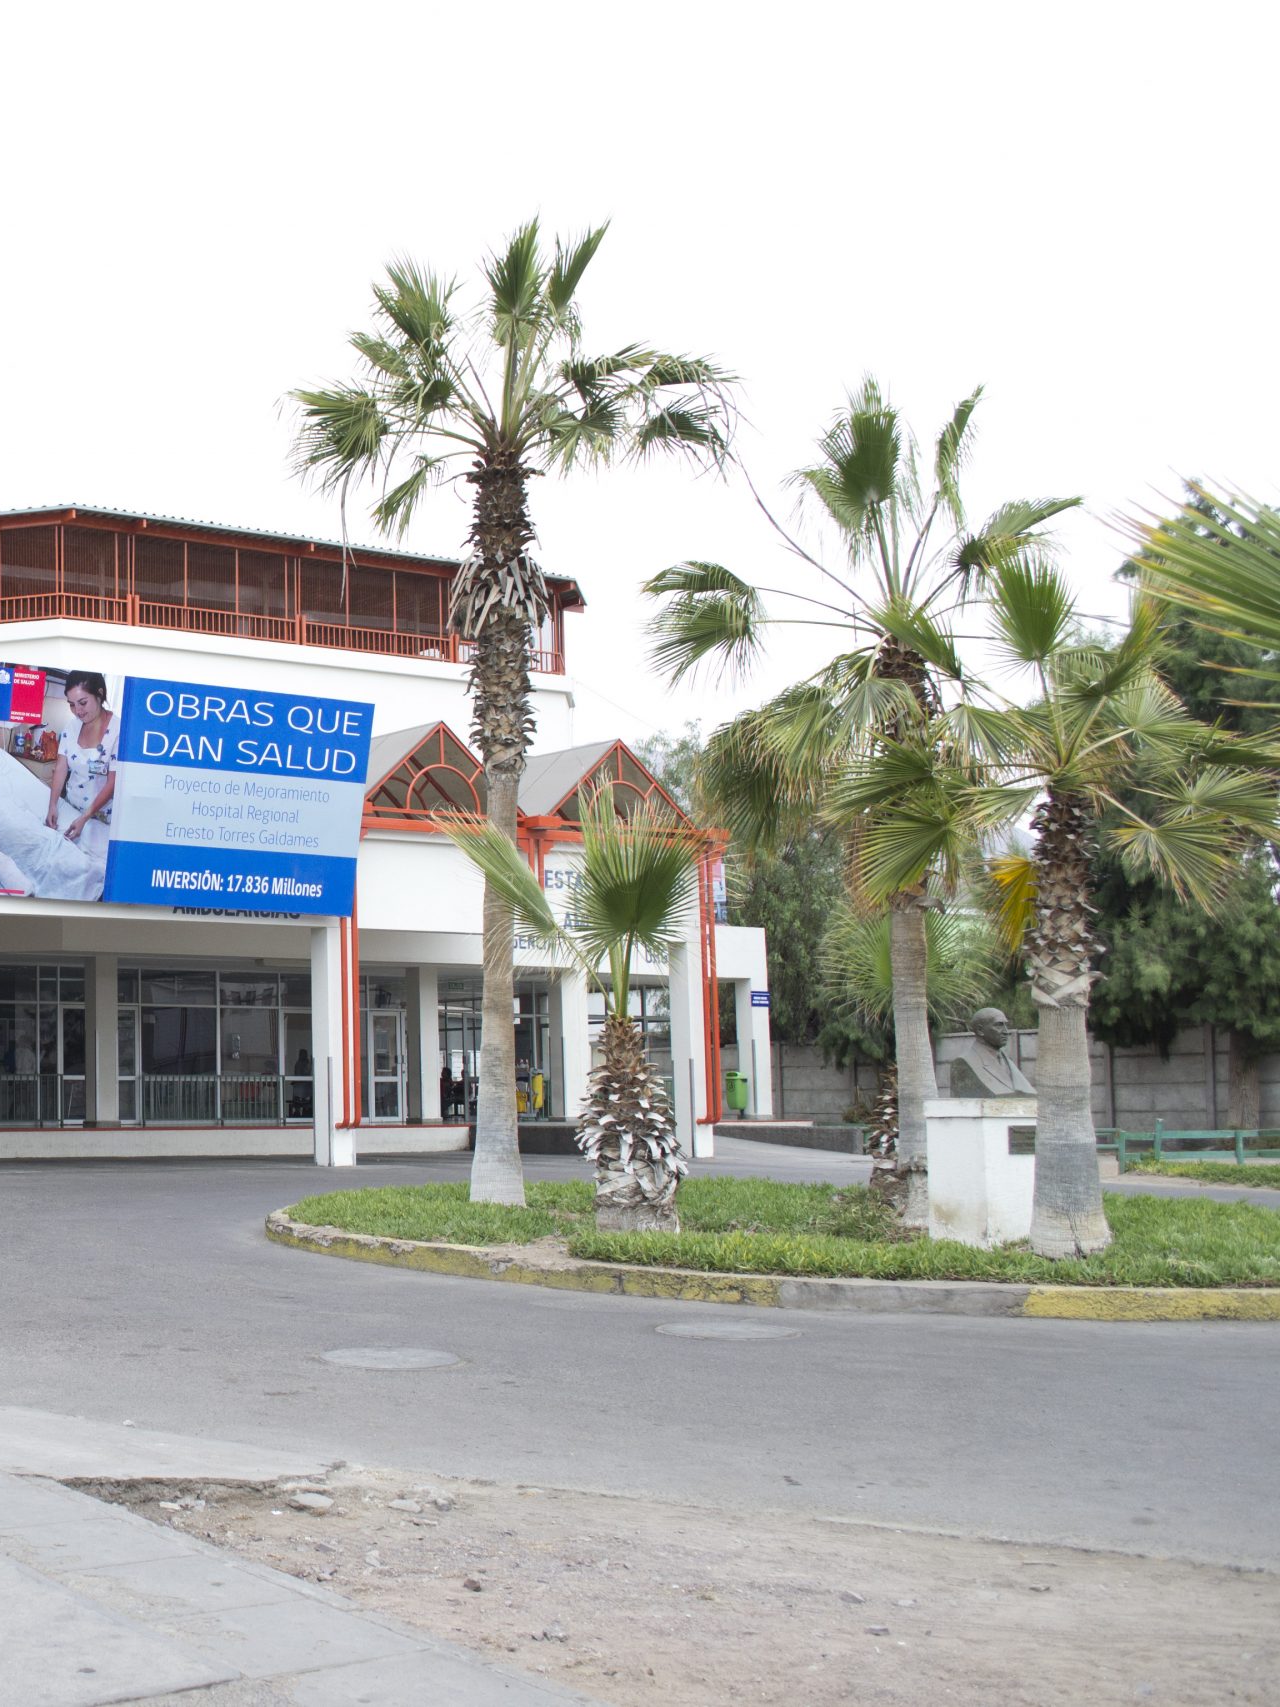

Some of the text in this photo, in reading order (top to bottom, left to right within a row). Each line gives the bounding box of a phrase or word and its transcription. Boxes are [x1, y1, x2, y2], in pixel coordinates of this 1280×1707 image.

[146, 691, 363, 737] OBRAS QUE
[142, 730, 356, 774] DAN SALUD
[164, 774, 330, 804] Proyecto de Mejoramiento
[191, 801, 299, 824] Hospital Regional
[165, 822, 320, 848] Ernesto Torres Galdames
[151, 868, 323, 898] INVERSIÓN: 17.836 Millones
